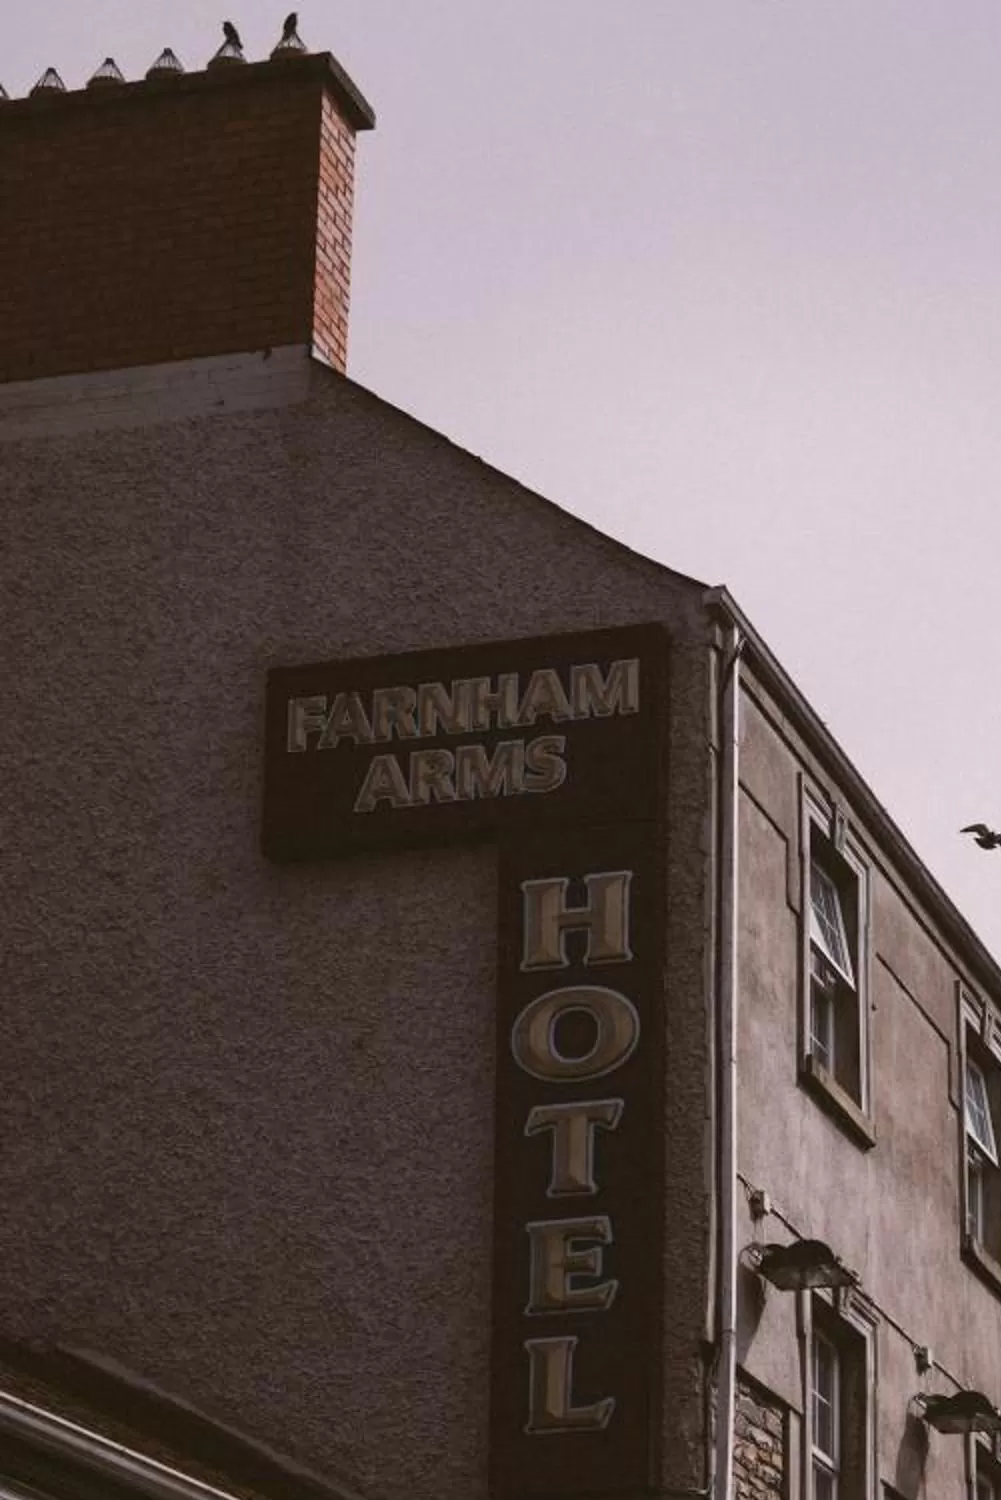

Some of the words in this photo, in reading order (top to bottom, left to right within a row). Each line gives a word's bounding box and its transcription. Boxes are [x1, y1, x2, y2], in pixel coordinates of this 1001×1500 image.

[287, 658, 641, 753] FARNHAM
[353, 734, 568, 813] ARMS
[511, 869, 641, 1436] HOTEL
